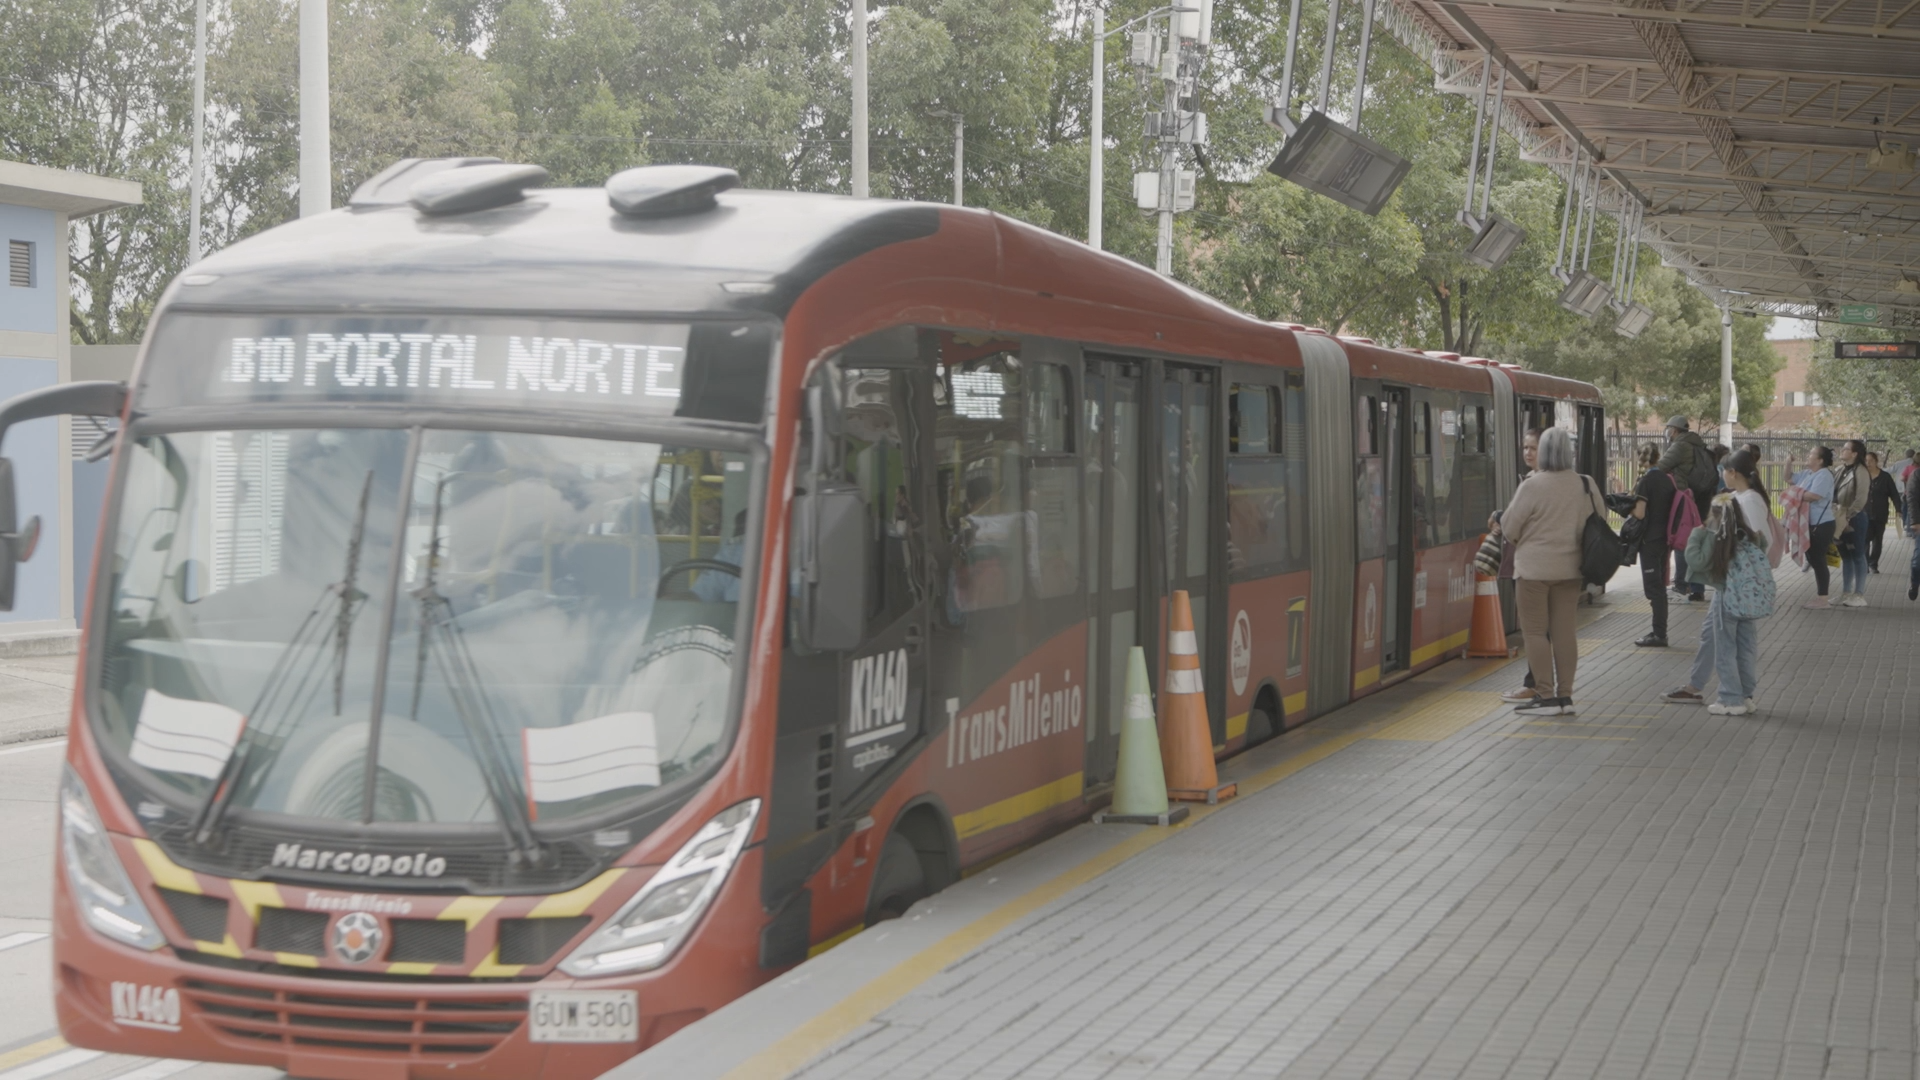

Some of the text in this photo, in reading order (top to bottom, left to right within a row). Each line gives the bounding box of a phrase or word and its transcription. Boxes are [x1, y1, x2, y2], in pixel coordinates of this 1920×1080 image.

[230, 333, 684, 397] B10 PORTAL NORTE
[850, 648, 908, 733] K1460
[946, 668, 1082, 768] TransMilenio
[271, 843, 447, 877] Marcopolo
[305, 892, 412, 915] TransMilenio
[110, 981, 180, 1025] K1460
[586, 1001, 634, 1028] 580
